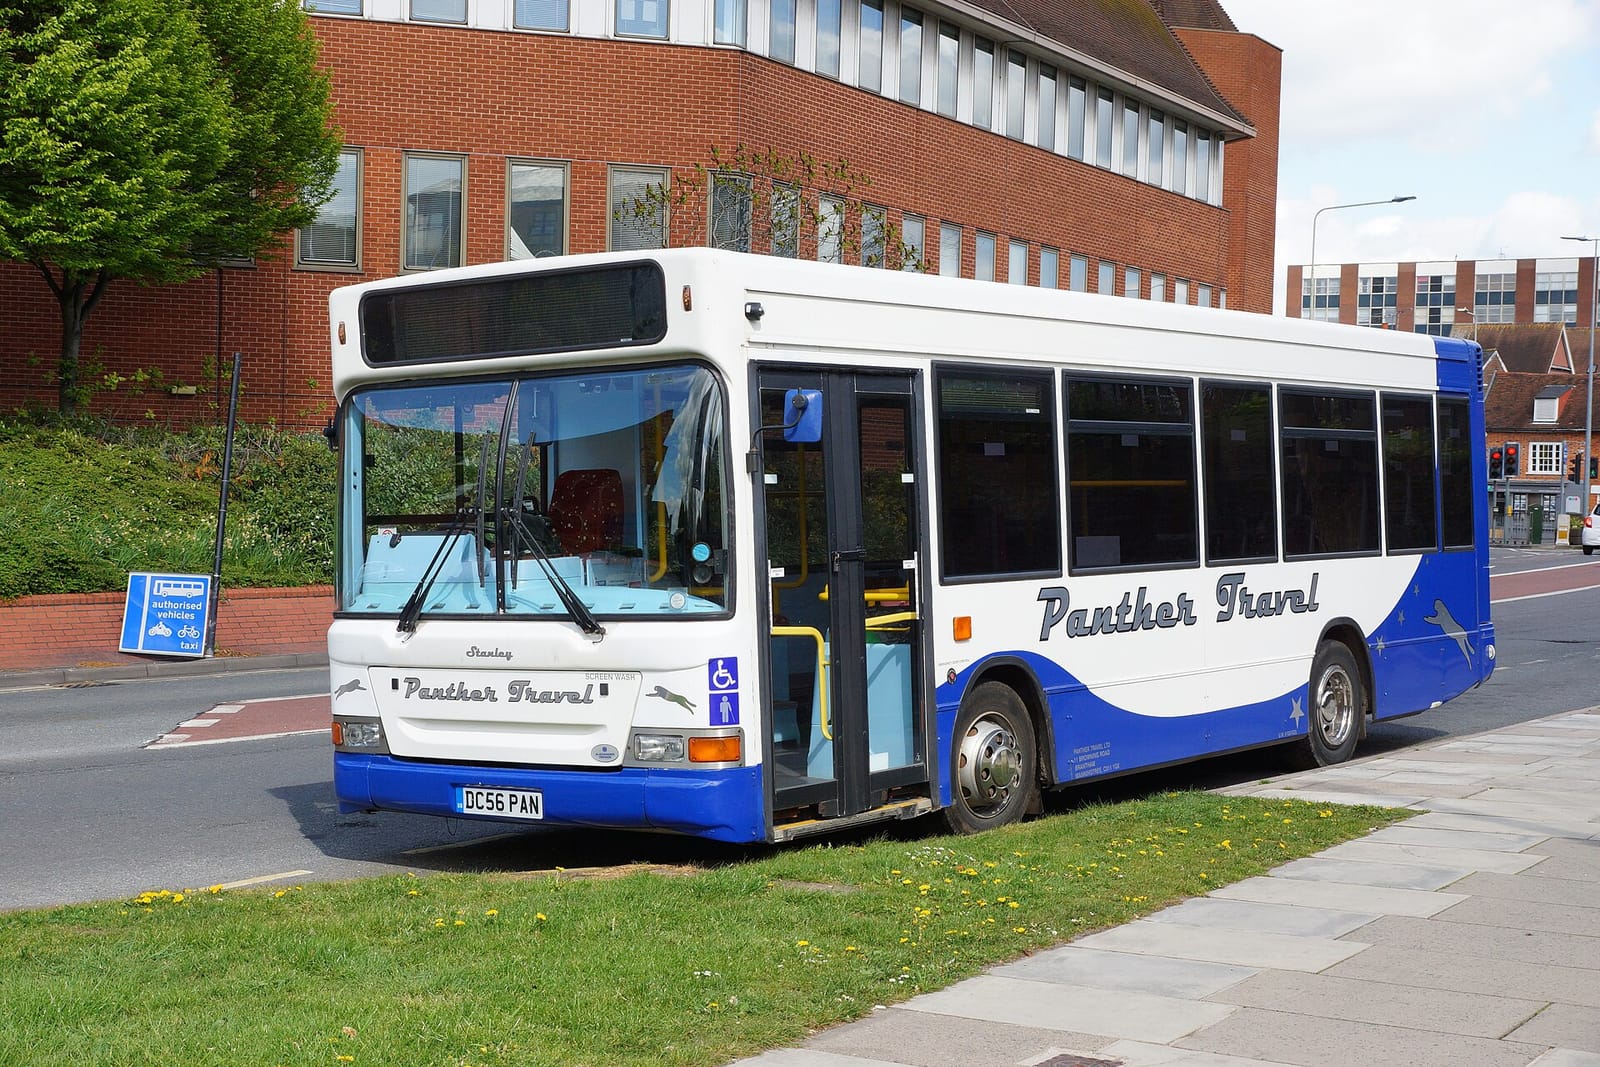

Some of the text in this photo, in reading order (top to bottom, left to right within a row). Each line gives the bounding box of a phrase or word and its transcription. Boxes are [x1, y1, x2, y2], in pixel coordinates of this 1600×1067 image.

[152, 601, 202, 610] authorised
[1037, 573, 1319, 641] Panther Travel
[157, 611, 195, 620] vehicles
[180, 641, 199, 649] taxi
[466, 646, 513, 661] Stanley
[614, 673, 635, 681] WASH
[404, 677, 594, 704] Panther Travel
[465, 791, 539, 814] DC56 PAN
